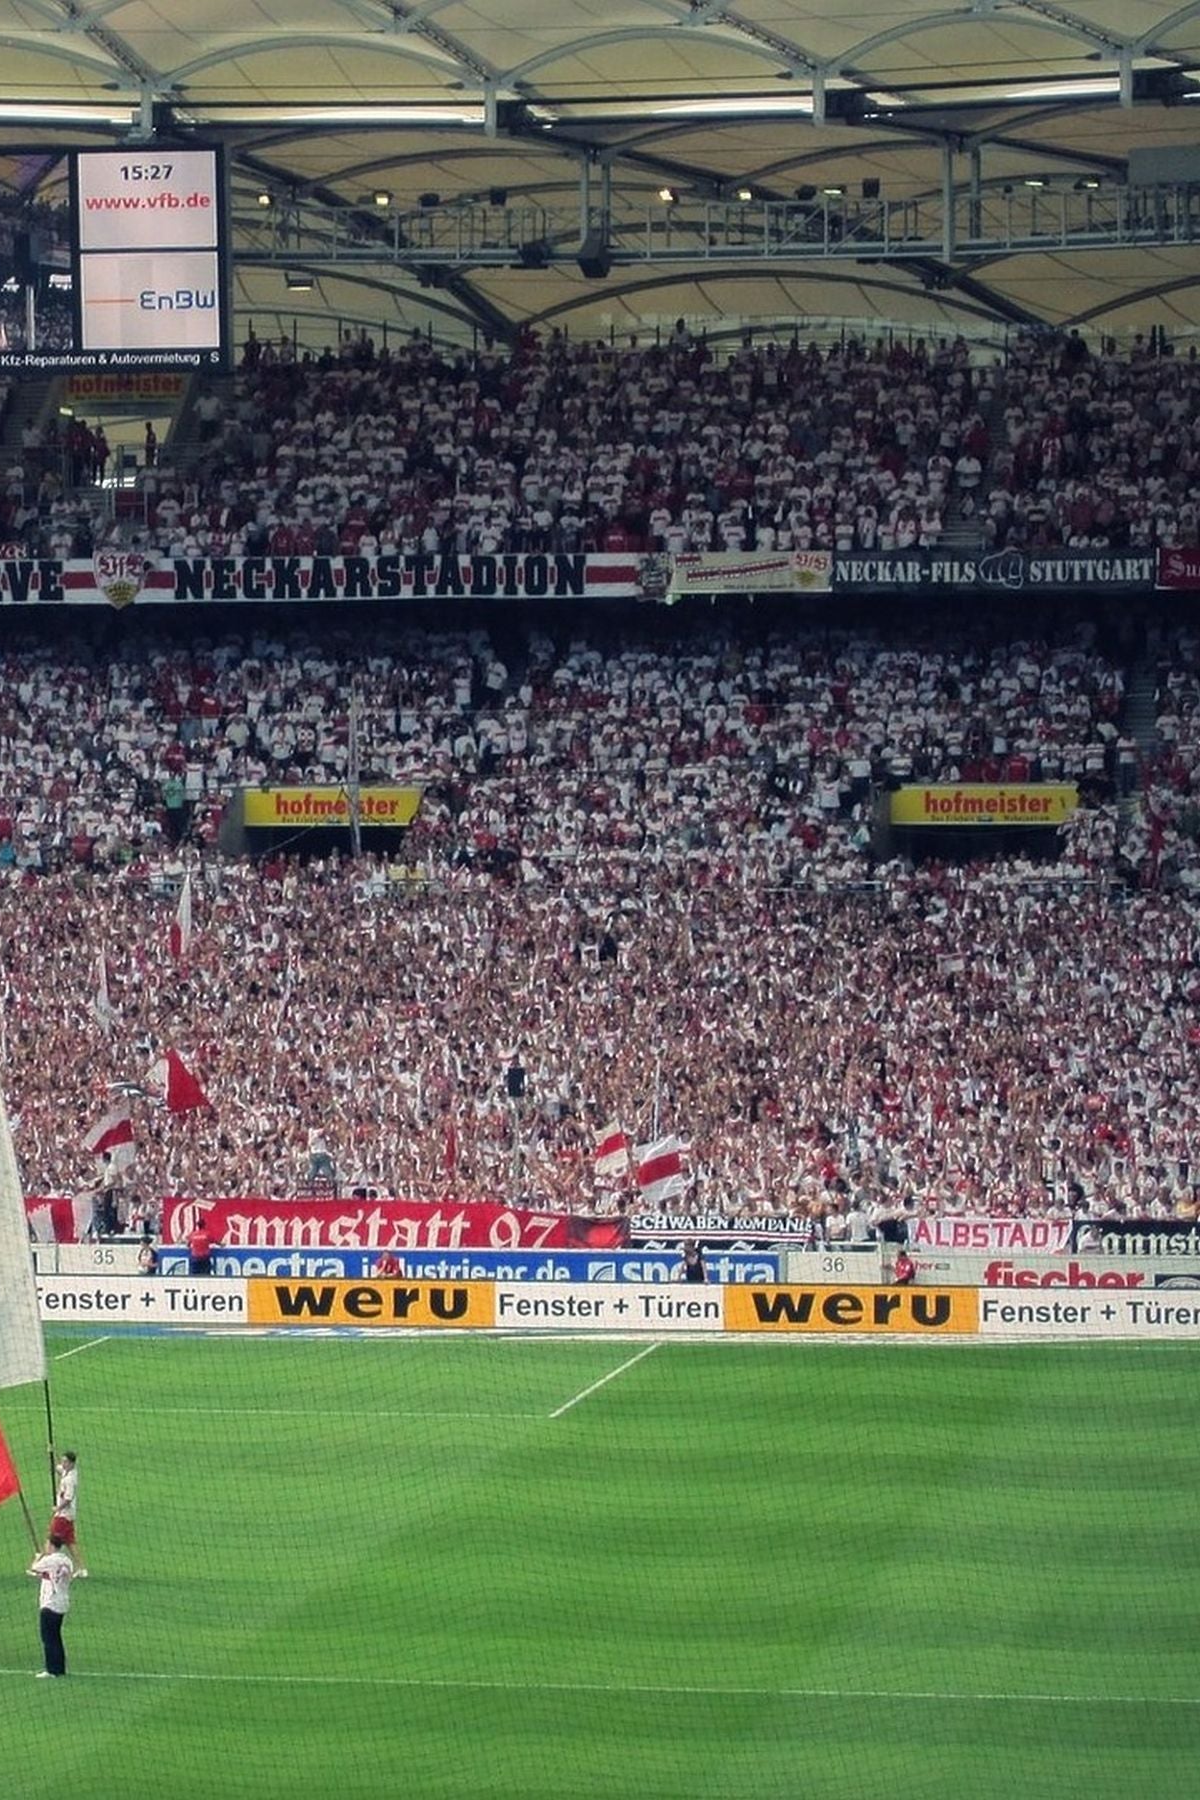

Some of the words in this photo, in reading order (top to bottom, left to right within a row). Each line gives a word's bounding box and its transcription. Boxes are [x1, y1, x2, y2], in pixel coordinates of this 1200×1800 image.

[120, 165, 173, 180] 15:27
[86, 193, 211, 209] www.vfb.de
[140, 290, 215, 310] EnBW
[1, 355, 95, 367] Kfz-Reparaturen
[98, 353, 107, 364] &
[110, 353, 200, 367] Autovermietung
[174, 555, 587, 600] NECKARSTADION
[835, 559, 975, 582] NECKAR-FILS
[1030, 557, 1153, 581] STUTTGART
[275, 794, 400, 815] hofmester
[924, 791, 1052, 813] hofmeister
[170, 1200, 471, 1247] Cannstatt
[490, 1211, 561, 1247] 97
[631, 1214, 729, 1230] SCHWABEN
[733, 1217, 813, 1232] KOMPANIE
[915, 1219, 1070, 1248] ALBSTADT
[94, 1251, 114, 1265] 35
[209, 1252, 344, 1277] pectra
[822, 1258, 844, 1272] 36
[622, 1257, 775, 1284] spetra
[984, 1261, 1145, 1287] fischer
[140, 1294, 155, 1307] +
[165, 1288, 243, 1312] Türen
[275, 1286, 469, 1320] weru
[499, 1293, 605, 1317] Fenster
[614, 1299, 629, 1313] +
[638, 1294, 719, 1318] Türen
[752, 1291, 951, 1326] weru
[983, 1300, 1091, 1323] Fenster
[1100, 1304, 1116, 1320] +
